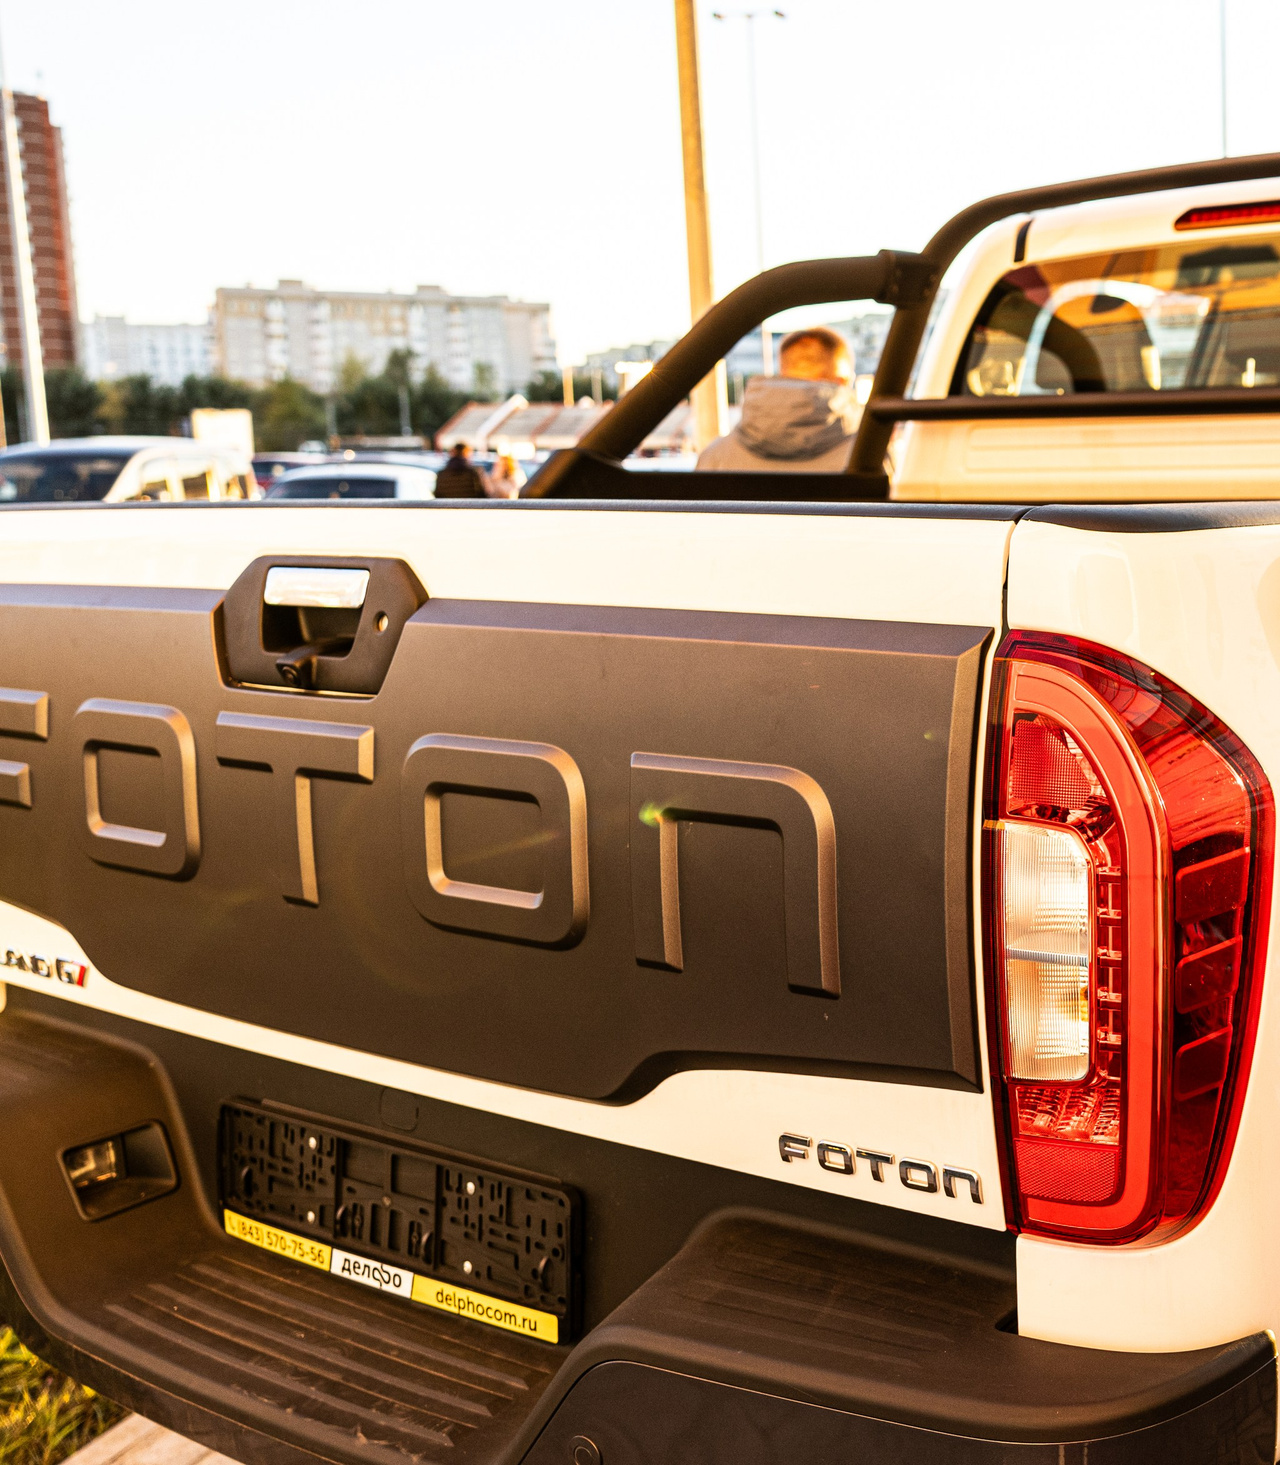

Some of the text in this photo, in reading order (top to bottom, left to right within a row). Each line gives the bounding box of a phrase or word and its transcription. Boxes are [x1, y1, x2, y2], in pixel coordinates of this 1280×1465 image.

[778, 1132, 984, 1205] FOTON
[266, 1231, 325, 1265] 570-75-56
[435, 1287, 539, 1333] delphocom.ru
